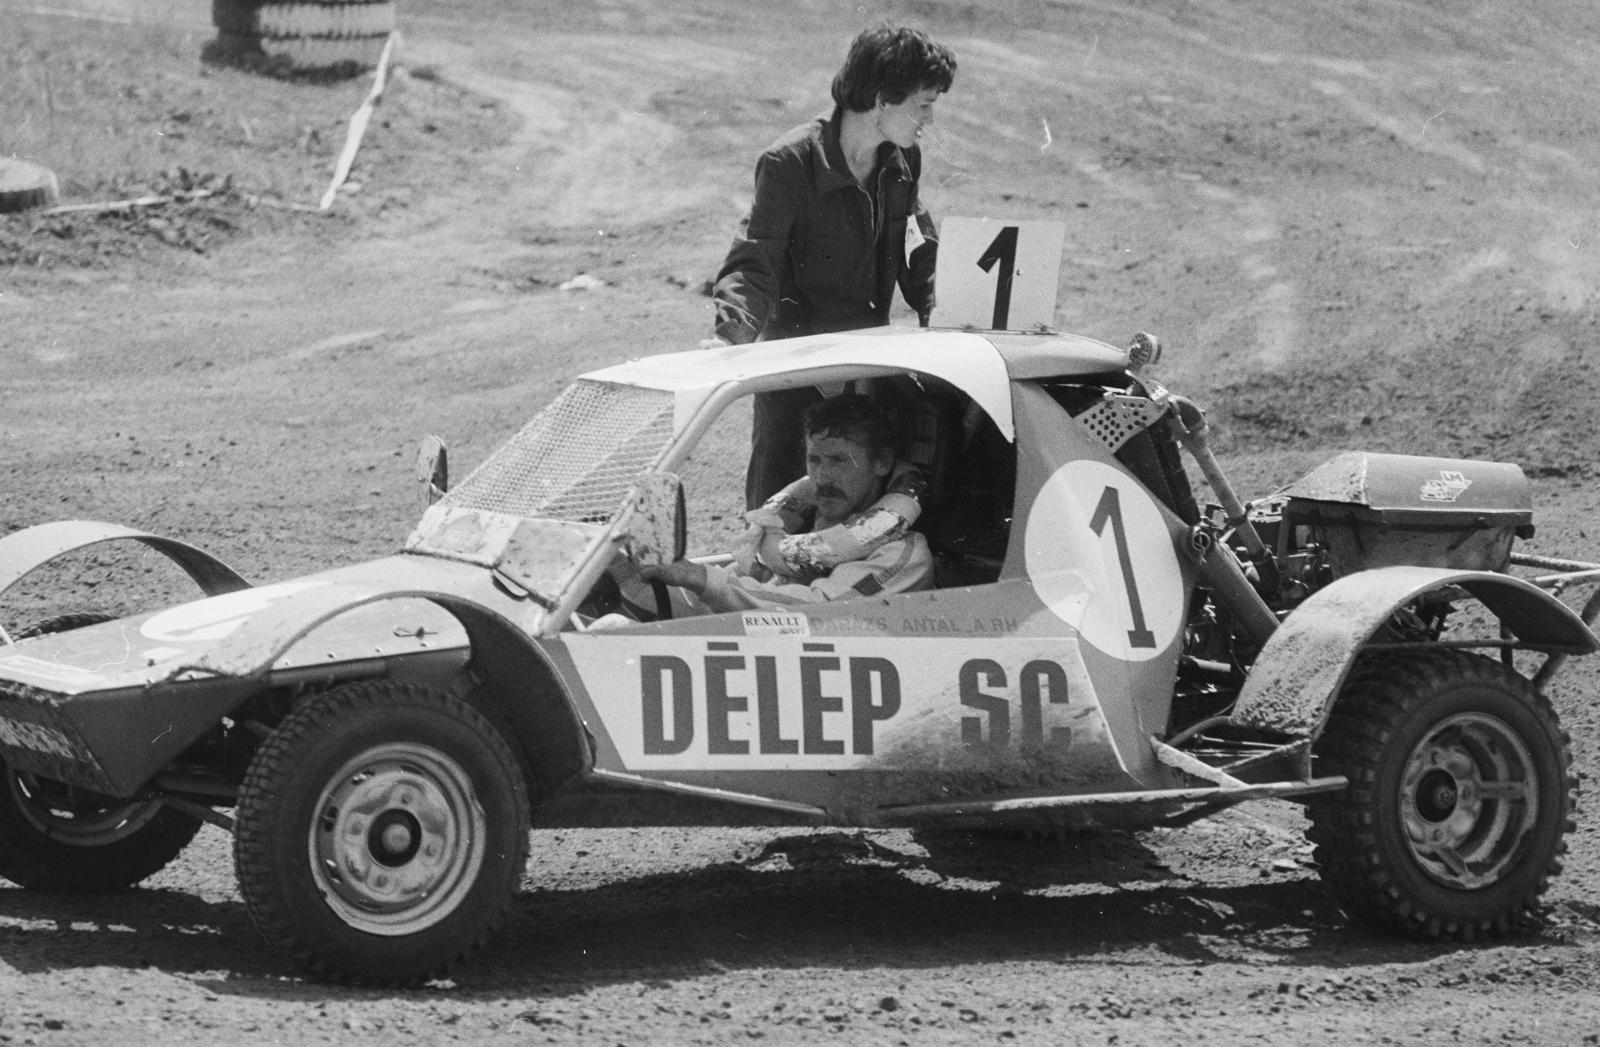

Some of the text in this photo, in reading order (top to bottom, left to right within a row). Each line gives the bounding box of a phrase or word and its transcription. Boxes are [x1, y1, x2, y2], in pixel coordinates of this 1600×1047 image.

[976, 226, 1019, 331] 1
[1089, 485, 1157, 649] 1
[902, 617, 961, 632] ANTAL
[959, 658, 1072, 757] SC
